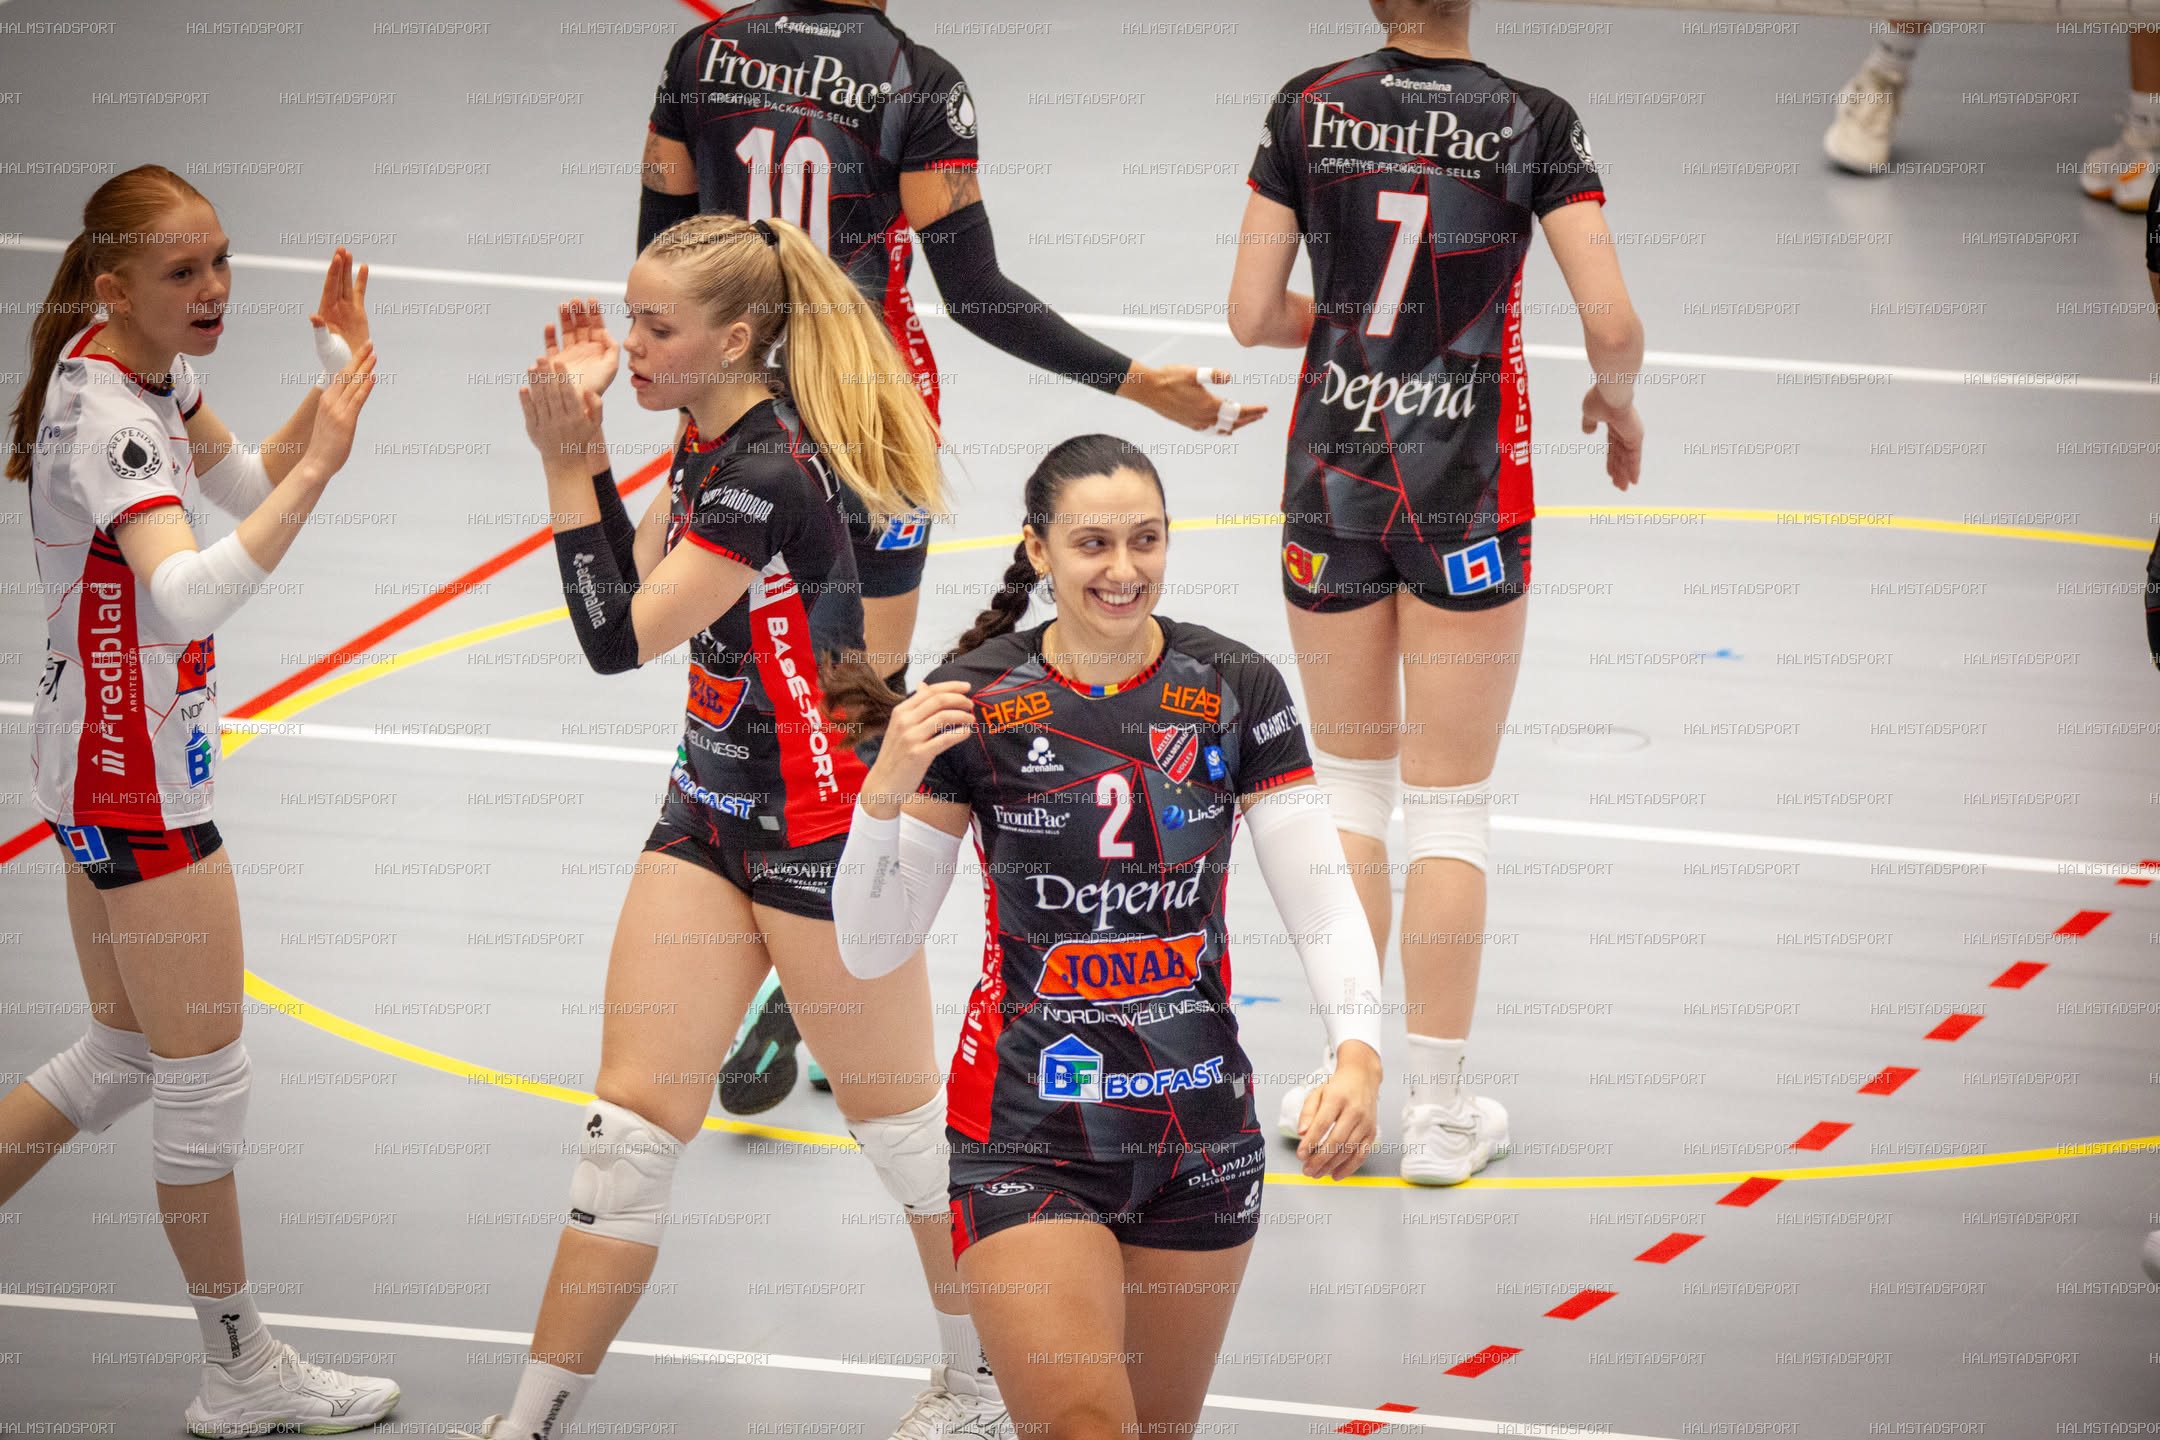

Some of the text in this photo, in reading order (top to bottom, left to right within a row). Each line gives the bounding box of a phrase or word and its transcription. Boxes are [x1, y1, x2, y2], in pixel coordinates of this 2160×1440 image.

[1394, 77, 1452, 92] adrenalina
[826, 113, 860, 128] SELLS
[1446, 167, 1481, 179] SELLS
[1365, 190, 1430, 337] 7
[1321, 359, 1480, 433] Depend
[981, 690, 1052, 730] HFAB
[1161, 682, 1221, 718] HFAB
[1020, 763, 1064, 774] adrenalina
[1095, 773, 1135, 858] 2
[1025, 856, 1206, 932] Depend
[1061, 947, 1186, 989] JONAB
[1104, 1055, 1224, 1100] BOFAST
